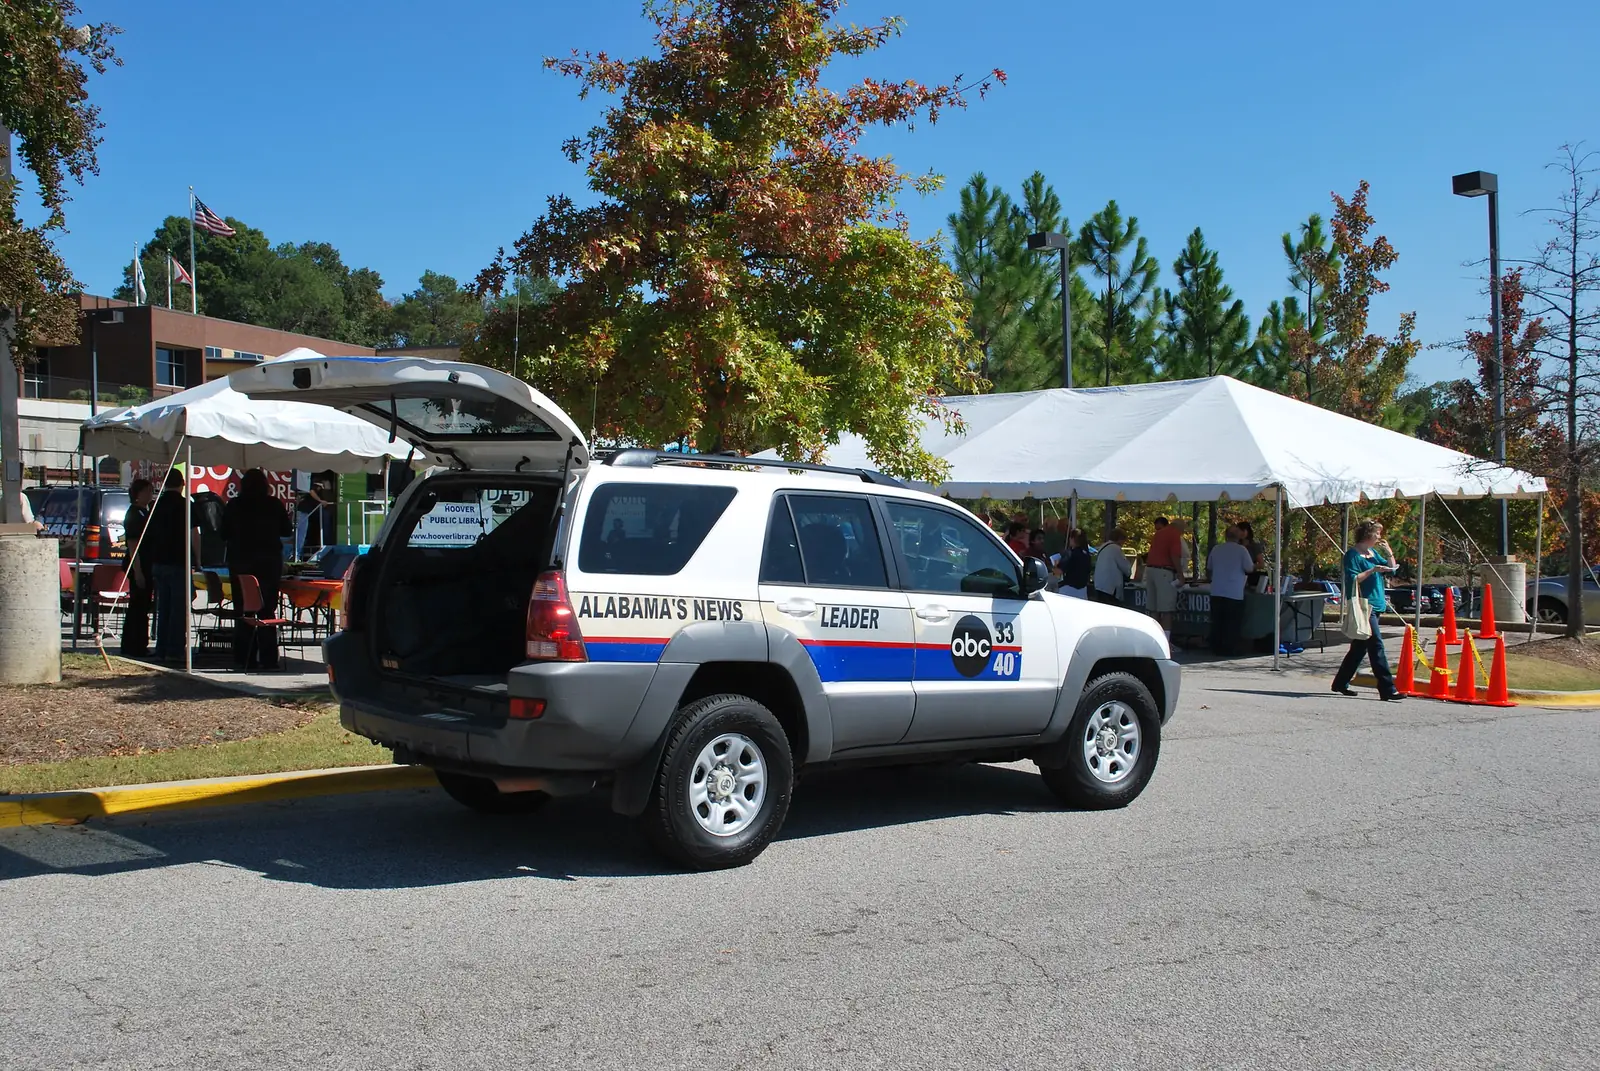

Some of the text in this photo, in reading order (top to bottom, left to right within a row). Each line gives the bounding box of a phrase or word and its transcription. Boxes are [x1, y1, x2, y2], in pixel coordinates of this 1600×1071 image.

[429, 516, 457, 524] PUBLIC
[444, 505, 475, 513] HOOVER
[578, 595, 880, 630] ALABAMA'S NEWS LEADER
[995, 621, 1015, 644] 33
[951, 632, 991, 658] abc
[992, 652, 1015, 676] 40
